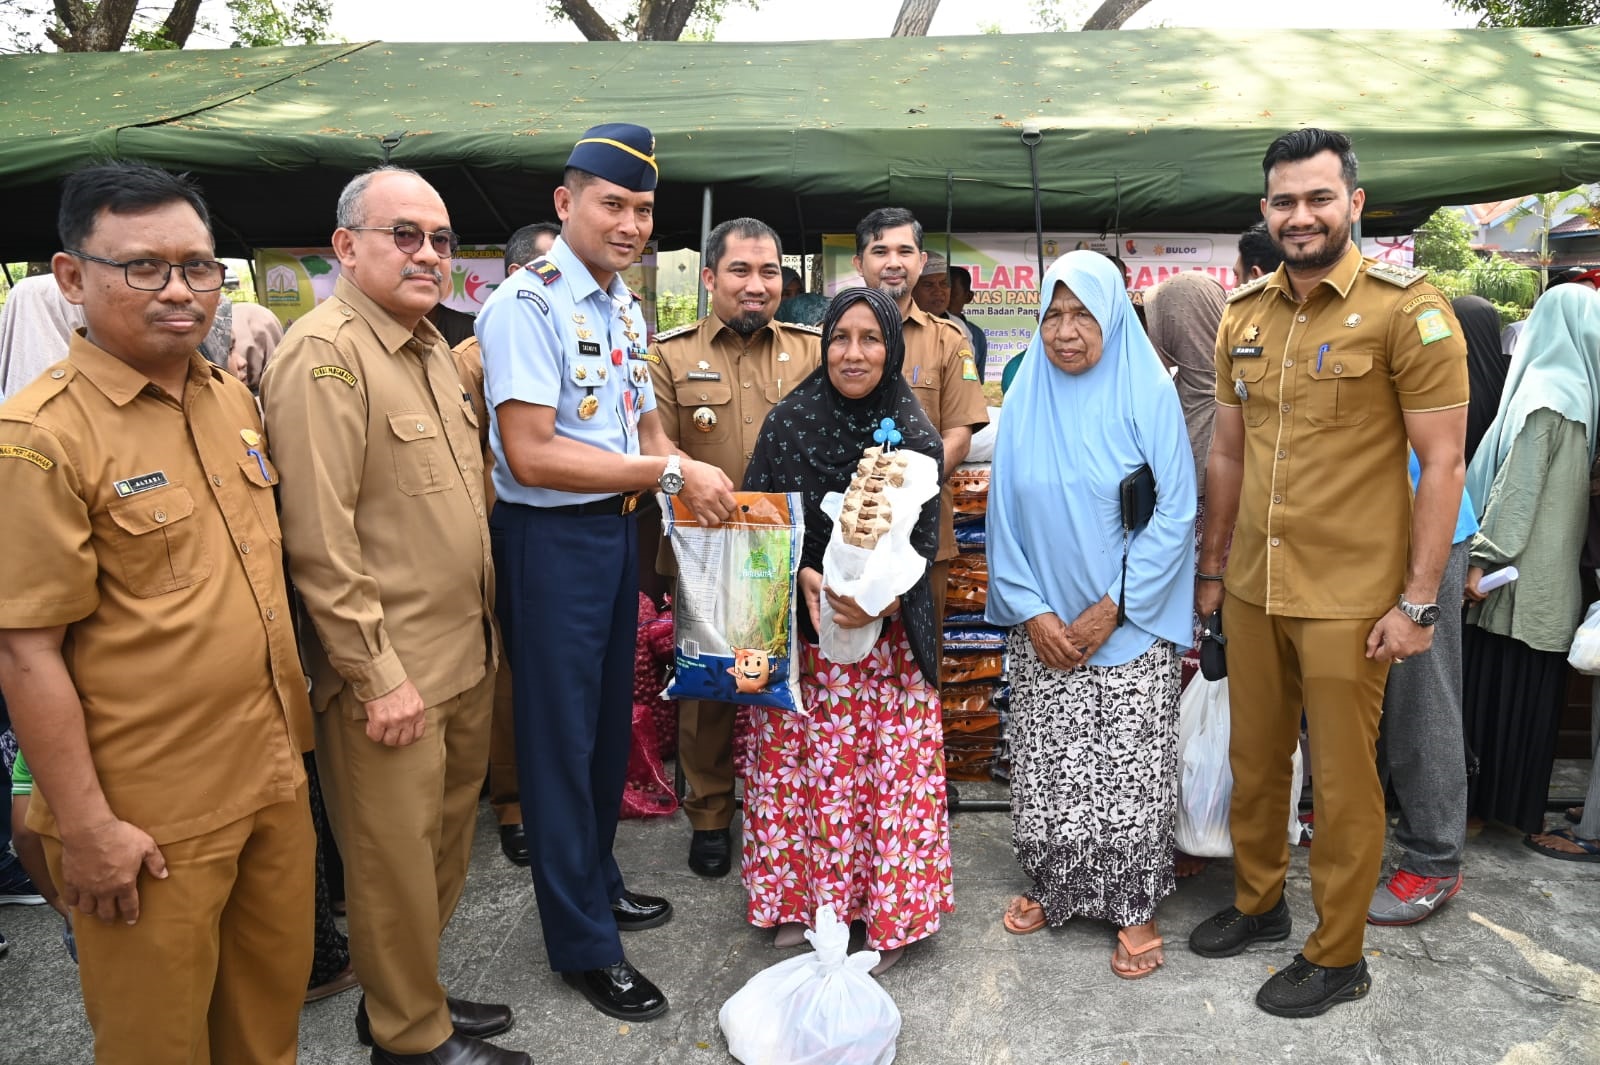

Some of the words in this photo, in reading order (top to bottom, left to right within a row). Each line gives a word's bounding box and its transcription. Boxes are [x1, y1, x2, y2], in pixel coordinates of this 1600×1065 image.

[961, 265, 1035, 290] LAR
[973, 291, 1003, 305] NAS
[1006, 291, 1041, 304] PAN
[987, 307, 1014, 315] Badan
[1018, 307, 1040, 317] Pang
[984, 329, 1009, 337] Beras
[1012, 329, 1017, 337] 5
[1019, 329, 1031, 338] Kg
[1017, 342, 1029, 350] Go
